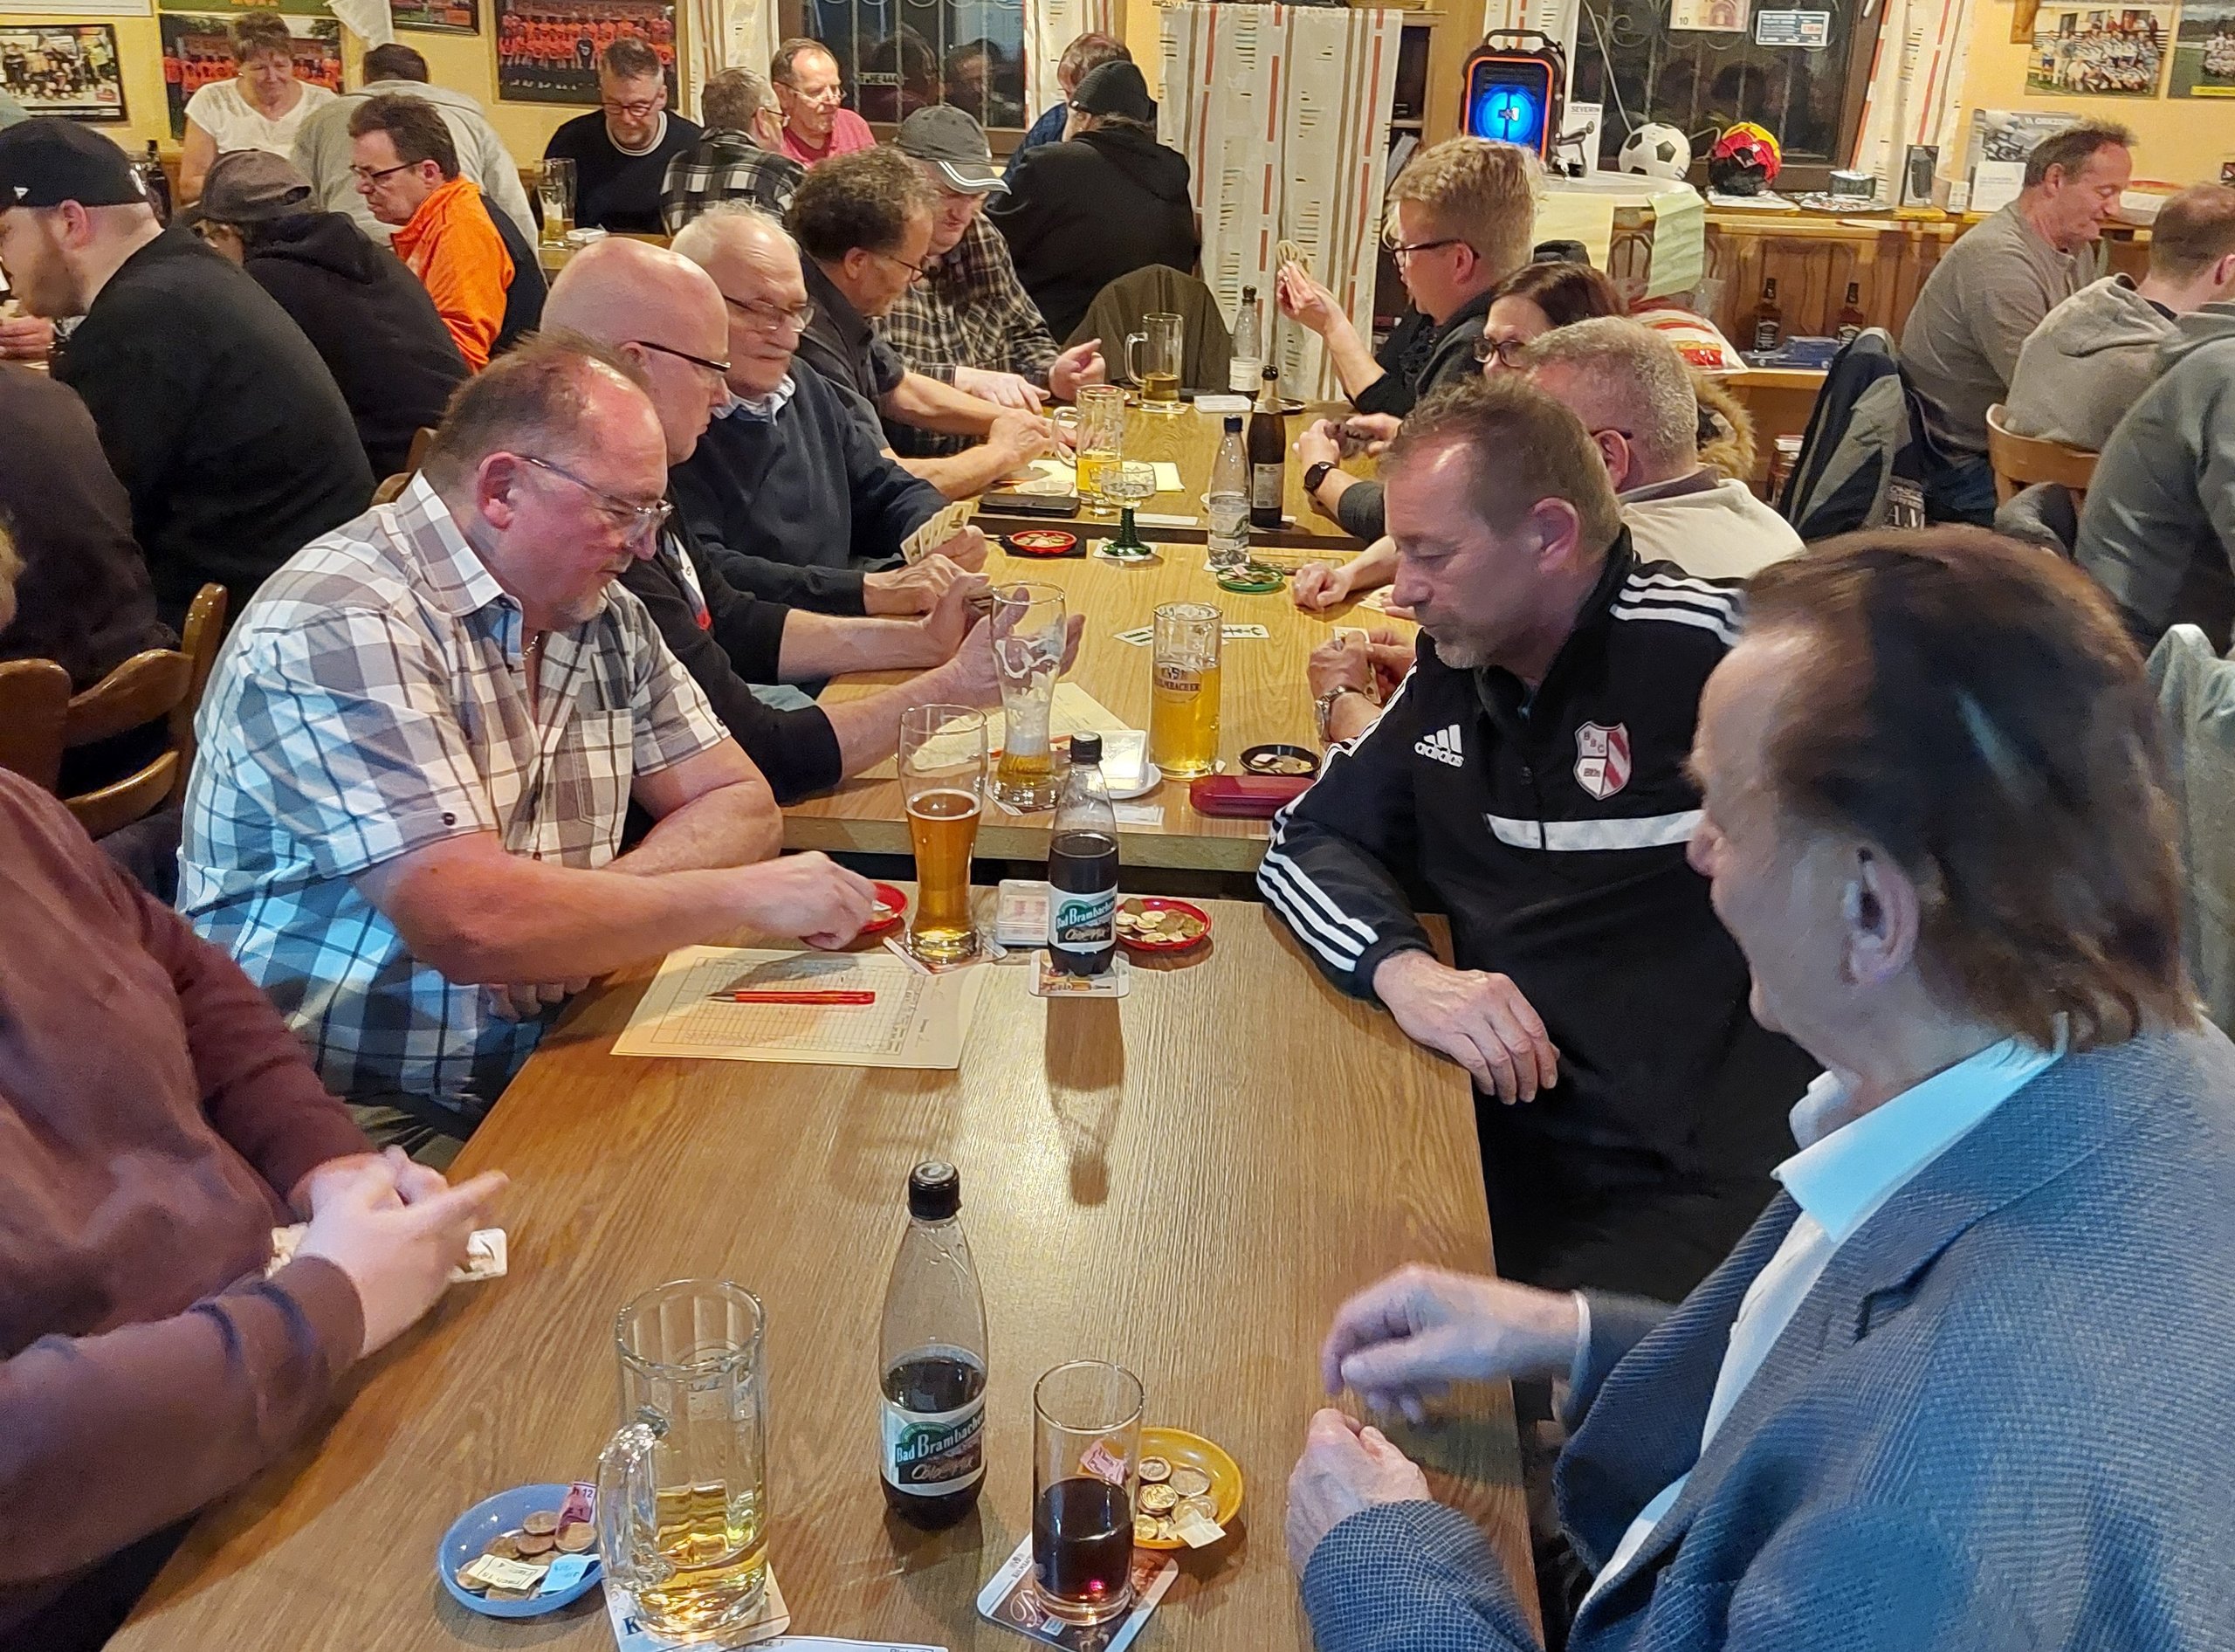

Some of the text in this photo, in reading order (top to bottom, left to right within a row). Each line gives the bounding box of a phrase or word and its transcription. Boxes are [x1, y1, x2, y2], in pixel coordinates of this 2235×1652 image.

[1413, 741, 1464, 767] adidas
[896, 1443, 916, 1463] Bad
[582, 1488, 594, 1498] 12
